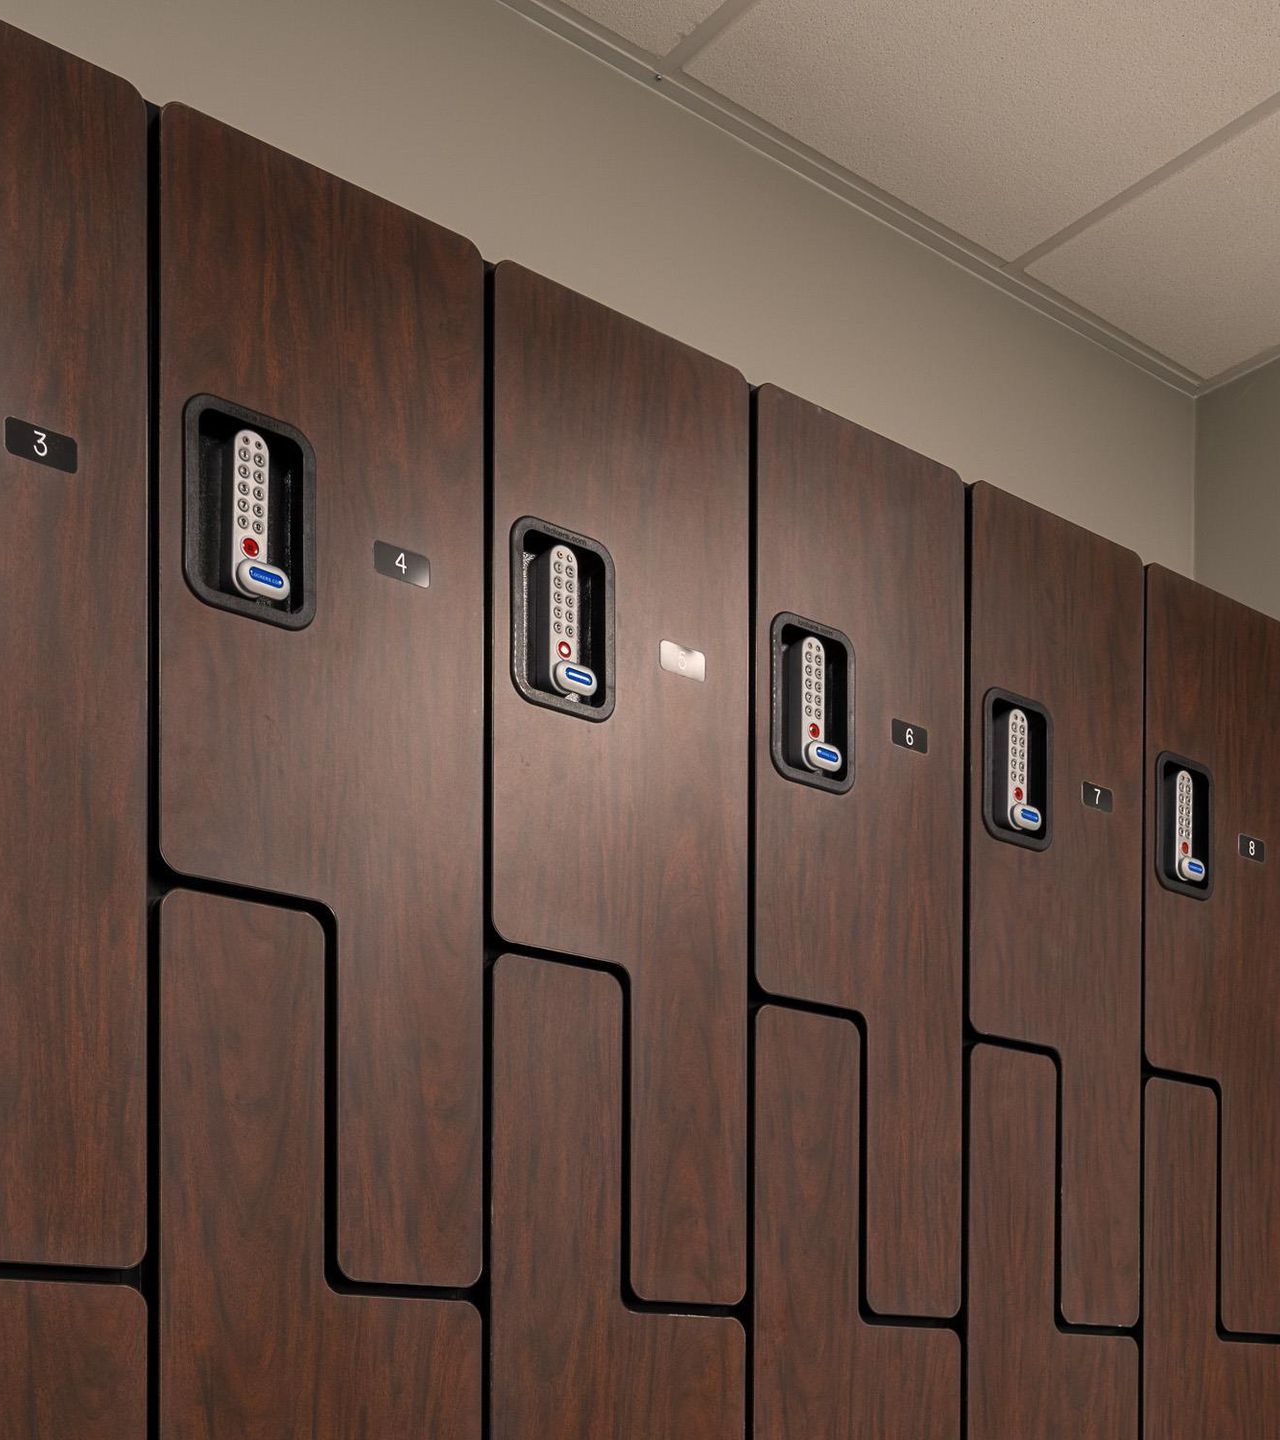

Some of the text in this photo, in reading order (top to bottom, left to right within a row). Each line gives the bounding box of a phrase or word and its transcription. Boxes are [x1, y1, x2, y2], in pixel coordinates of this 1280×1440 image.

[32, 431, 48, 457] 3
[394, 553, 408, 574] 4
[677, 652, 686, 670] 5
[905, 729, 914, 746] 6
[1093, 789, 1101, 805] 7
[1248, 841, 1255, 856] 8
